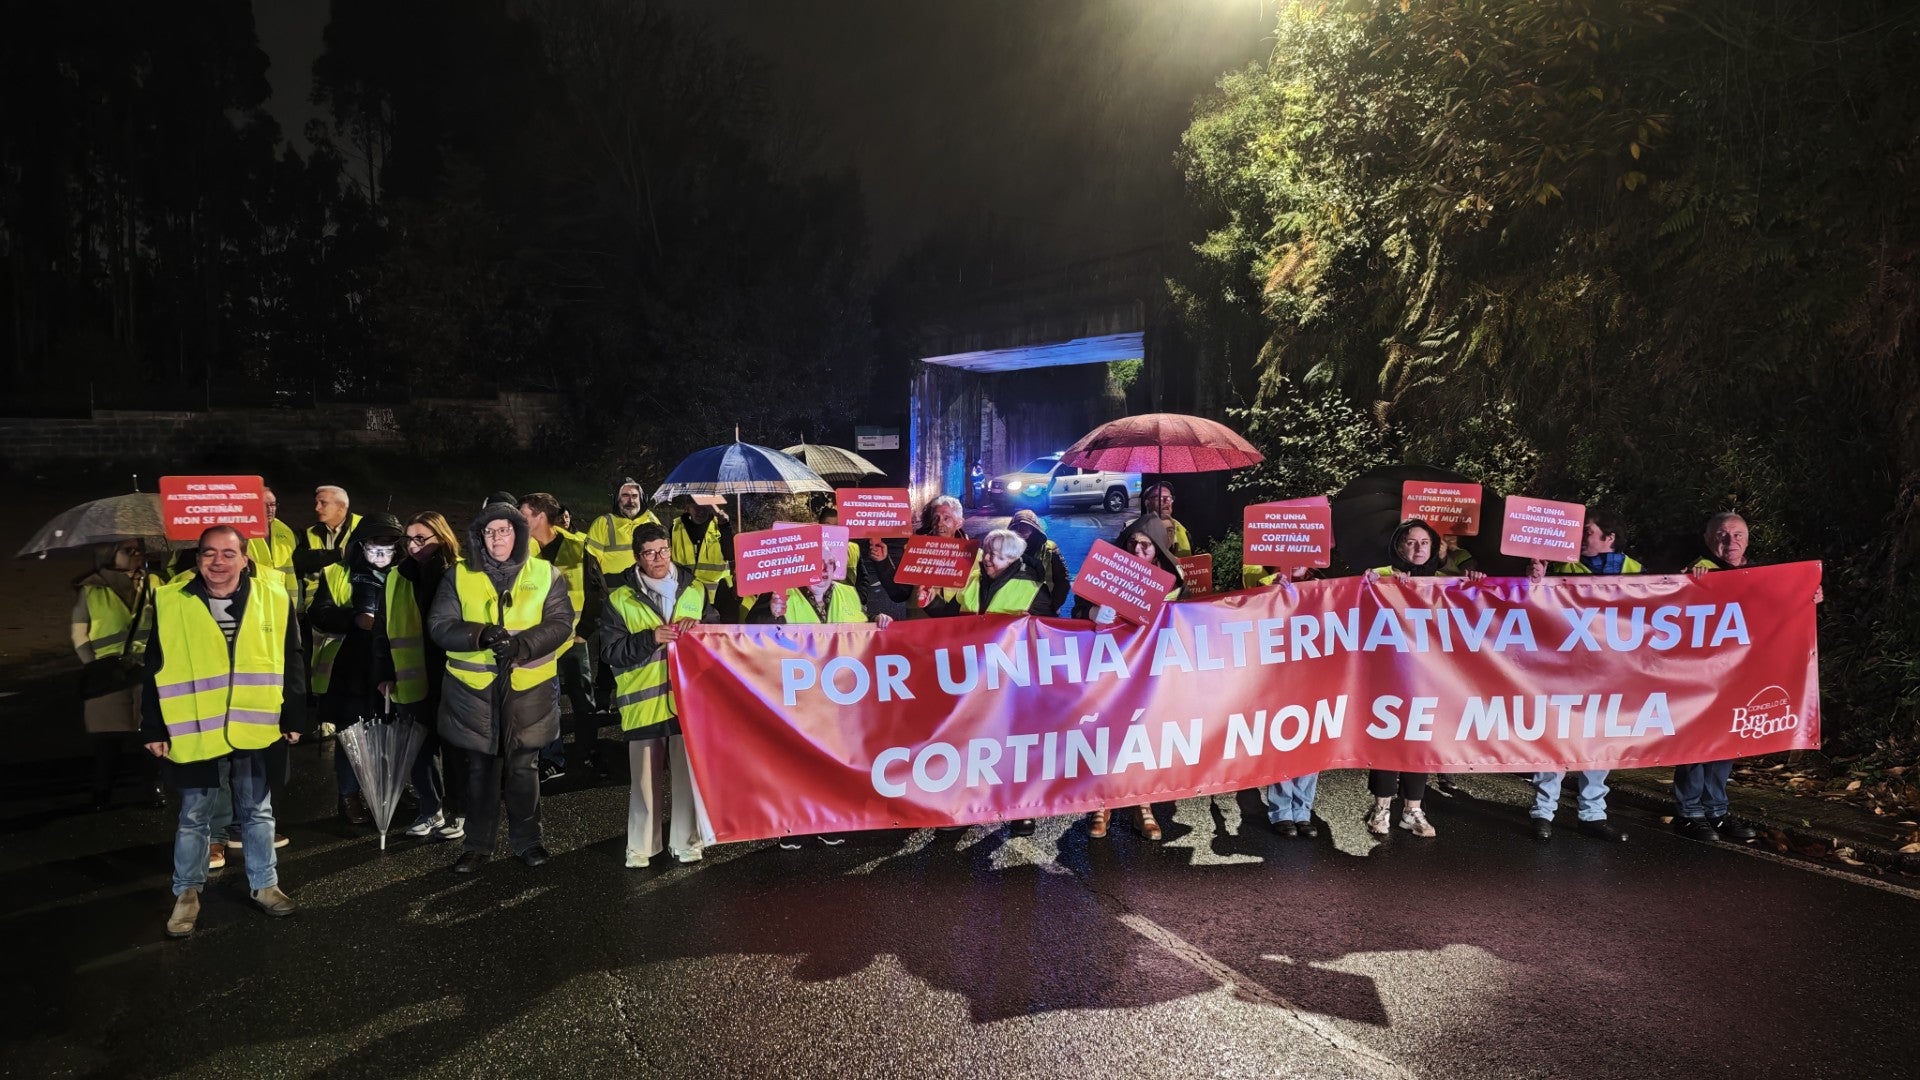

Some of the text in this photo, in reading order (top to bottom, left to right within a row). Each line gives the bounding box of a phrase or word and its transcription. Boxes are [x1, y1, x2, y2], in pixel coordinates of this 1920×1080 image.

[185, 503, 243, 513] CORTIÑÁN
[1419, 505, 1462, 513] CORTIÑÁN
[1544, 508, 1565, 516] UNHA
[1510, 512, 1580, 527] ALTERNATIVA XUSTA
[1262, 533, 1310, 542] CORTIÑÁN
[1522, 526, 1566, 537] CORTIÑÁN
[760, 534, 802, 546] POR UNHA
[1510, 534, 1531, 544] NON
[1544, 539, 1575, 549] MUTILA
[743, 541, 818, 558] ALTERNATIVA XUSTA
[908, 548, 950, 556] ALTERNATIVA
[758, 554, 805, 568] CORTIÑÁN
[1113, 552, 1152, 576] POR UNHA
[746, 564, 816, 581] NON SE MUTILA
[904, 565, 922, 573] NON
[934, 567, 963, 577] MUTILA
[1092, 553, 1164, 592] ALTERNATIVA XUSTA
[1100, 570, 1146, 597] CORTIÑÁN
[1085, 574, 1152, 611] NON SE MUTILA
[781, 602, 1750, 706] POR UNHA ALTERNATIVA XUSTA
[1748, 701, 1778, 711] CONCELLO
[1728, 705, 1798, 738] Bergondo
[871, 692, 1675, 798] CORTIÑÁN NON SE MUTILA
